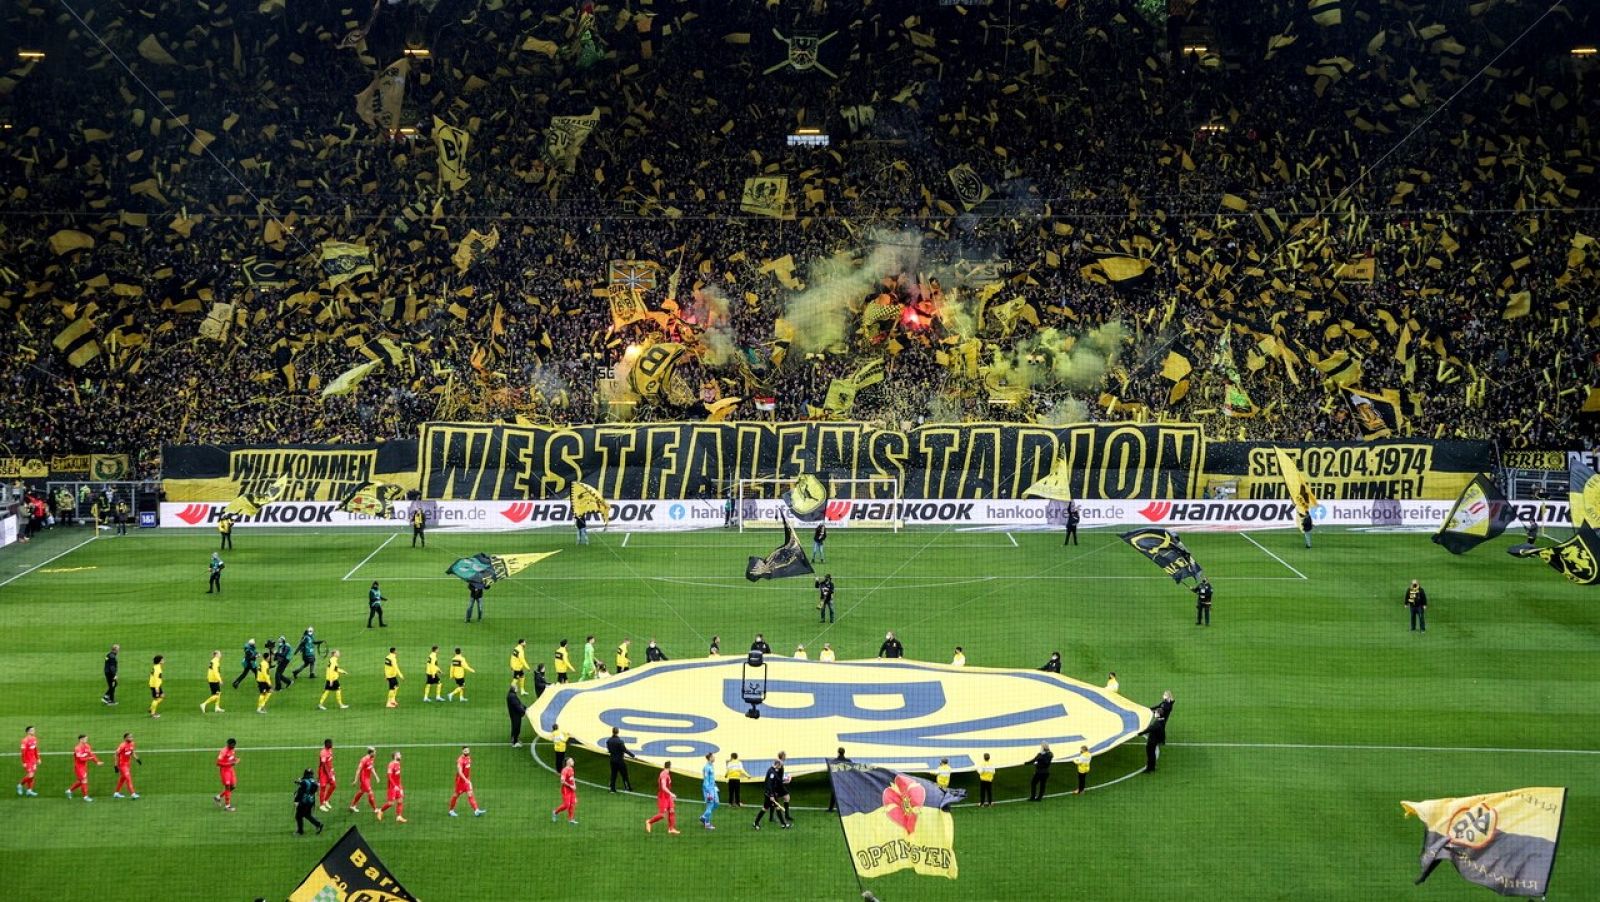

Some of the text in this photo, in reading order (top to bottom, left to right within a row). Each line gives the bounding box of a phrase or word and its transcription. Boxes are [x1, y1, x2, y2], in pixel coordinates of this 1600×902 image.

[232, 453, 373, 481] WILLKOMMEN
[1253, 447, 1426, 477] SE 02.04.1974
[238, 480, 320, 501] ZUCK
[986, 505, 1125, 519] hankookrefen.de
